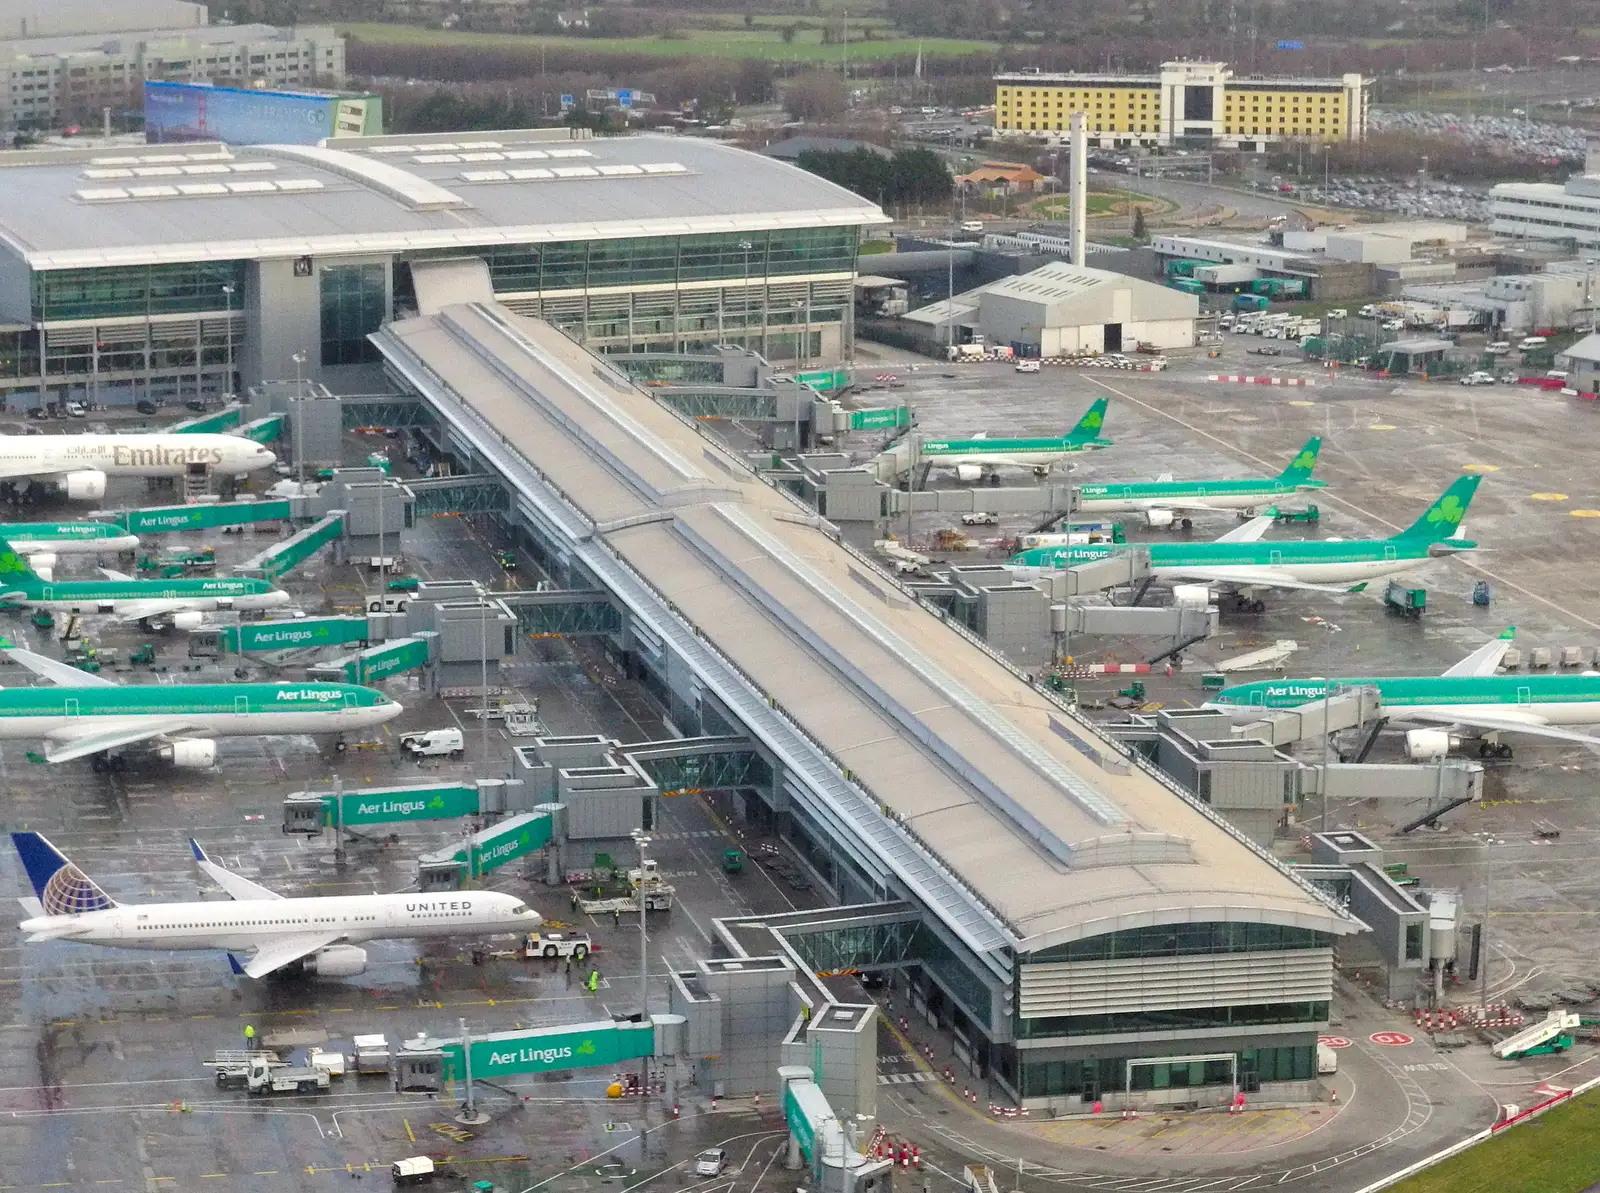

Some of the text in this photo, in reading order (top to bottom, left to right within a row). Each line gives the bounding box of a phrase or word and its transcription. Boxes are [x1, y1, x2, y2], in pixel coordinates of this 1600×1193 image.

[113, 444, 222, 466] Emirates
[1085, 487, 1108, 495] Lingus
[140, 515, 189, 527] Aer Lingus
[71, 526, 96, 534] Lingus
[1054, 550, 1108, 560] Aer Lingus
[217, 582, 244, 591] Lingus
[254, 630, 313, 643] Aer Lingus
[378, 656, 401, 671] Lingus
[276, 689, 343, 702] Aer Lingus
[1266, 686, 1288, 696] Aer
[358, 800, 426, 814] Aer Lingus
[479, 838, 519, 864] Aer Lingus
[406, 901, 472, 912] UNITED
[489, 1046, 573, 1066] Aer Lingus
